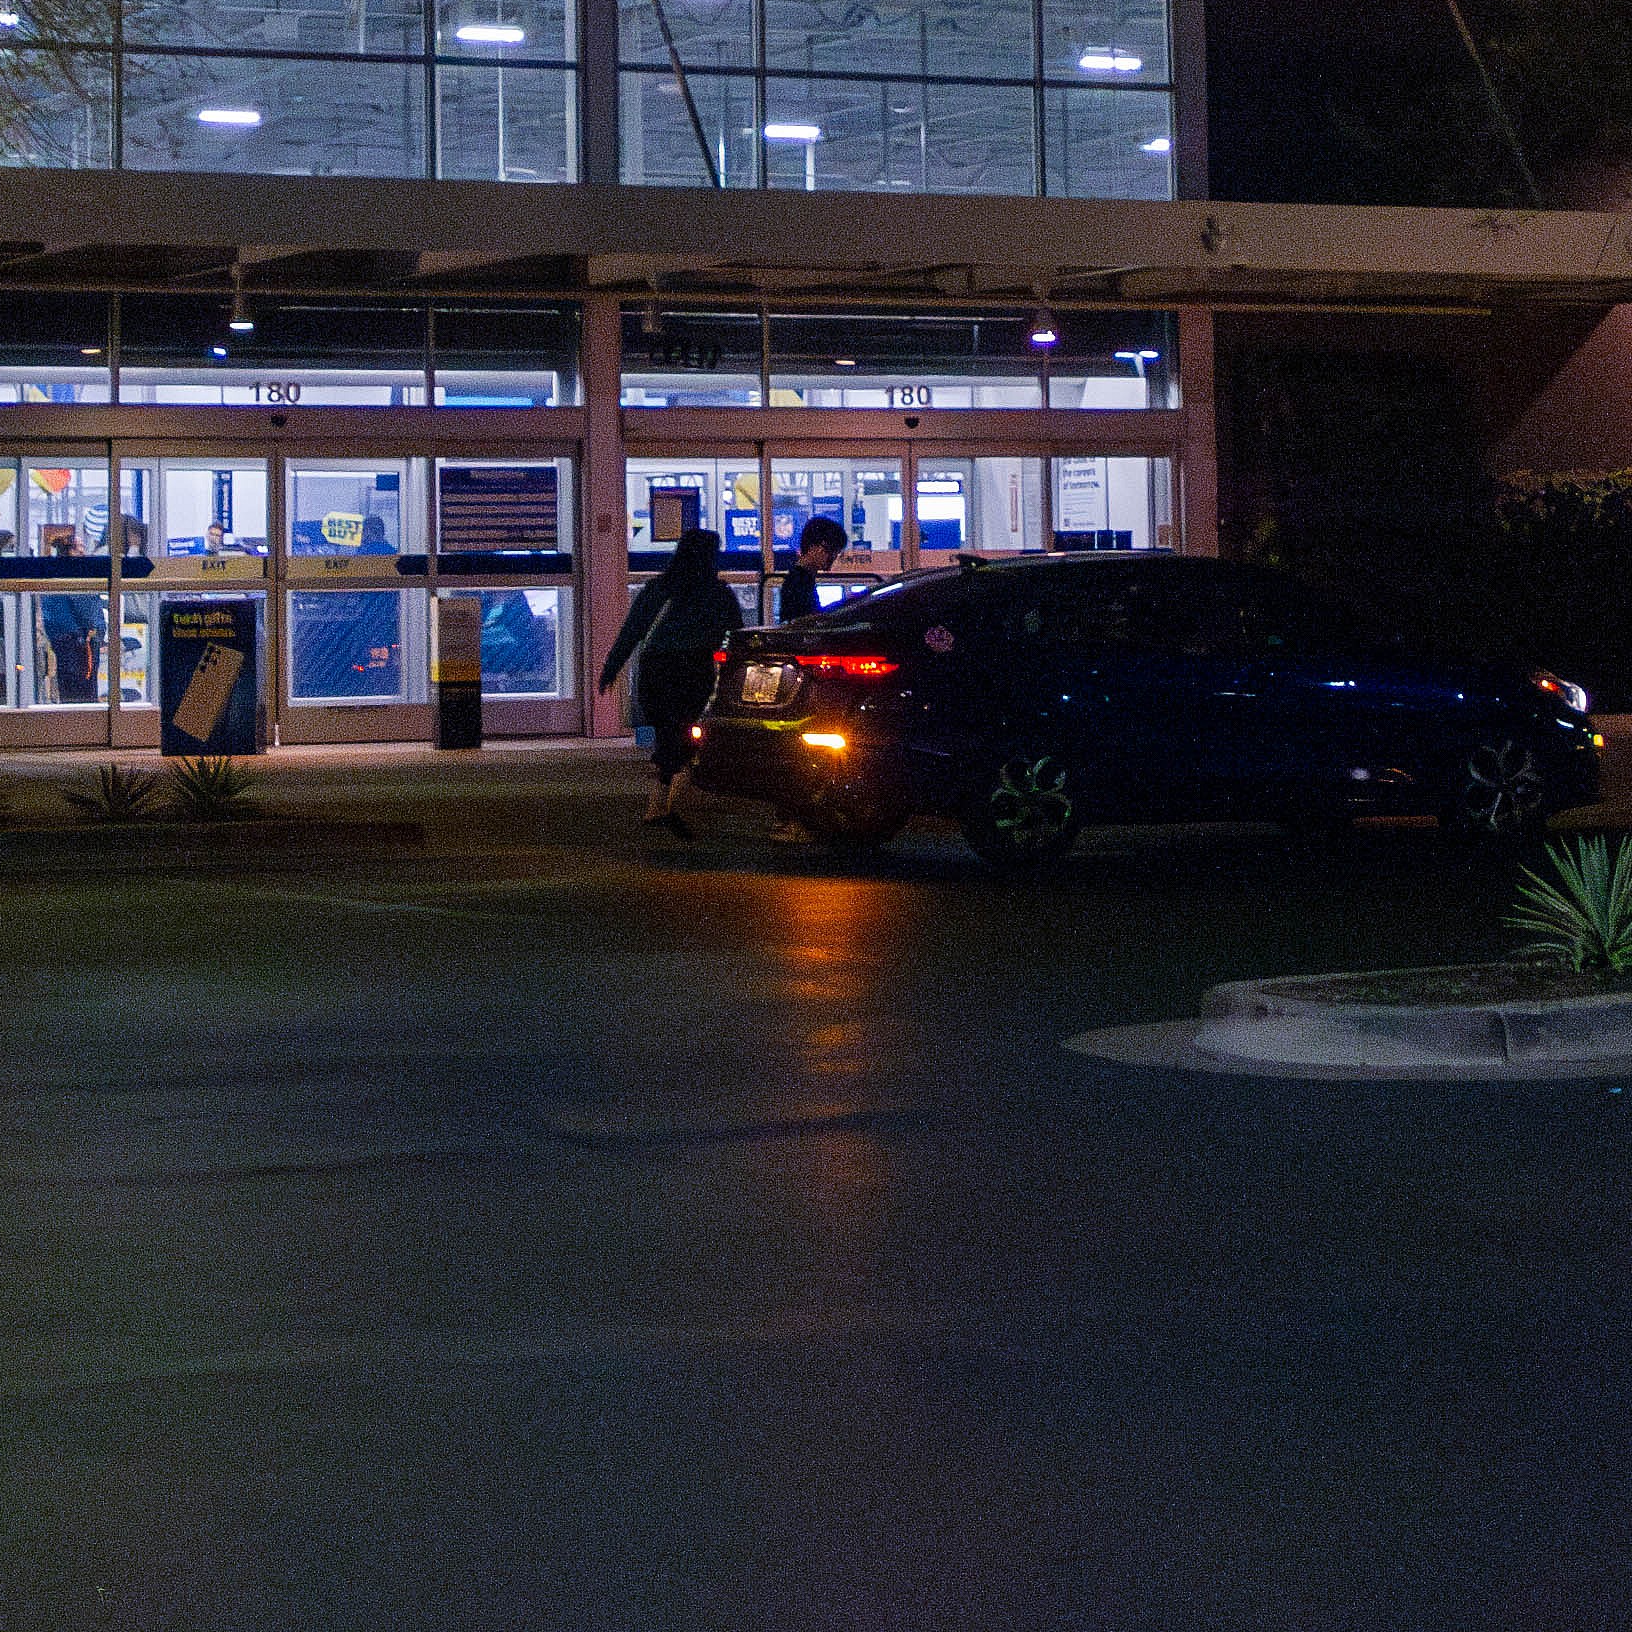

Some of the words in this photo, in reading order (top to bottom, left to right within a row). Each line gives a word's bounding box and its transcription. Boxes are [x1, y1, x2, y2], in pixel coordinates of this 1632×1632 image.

[248, 381, 302, 404] 180
[884, 384, 932, 406] 180
[327, 518, 361, 533] BEST
[328, 528, 357, 540] BUY
[201, 559, 227, 571] EXIT
